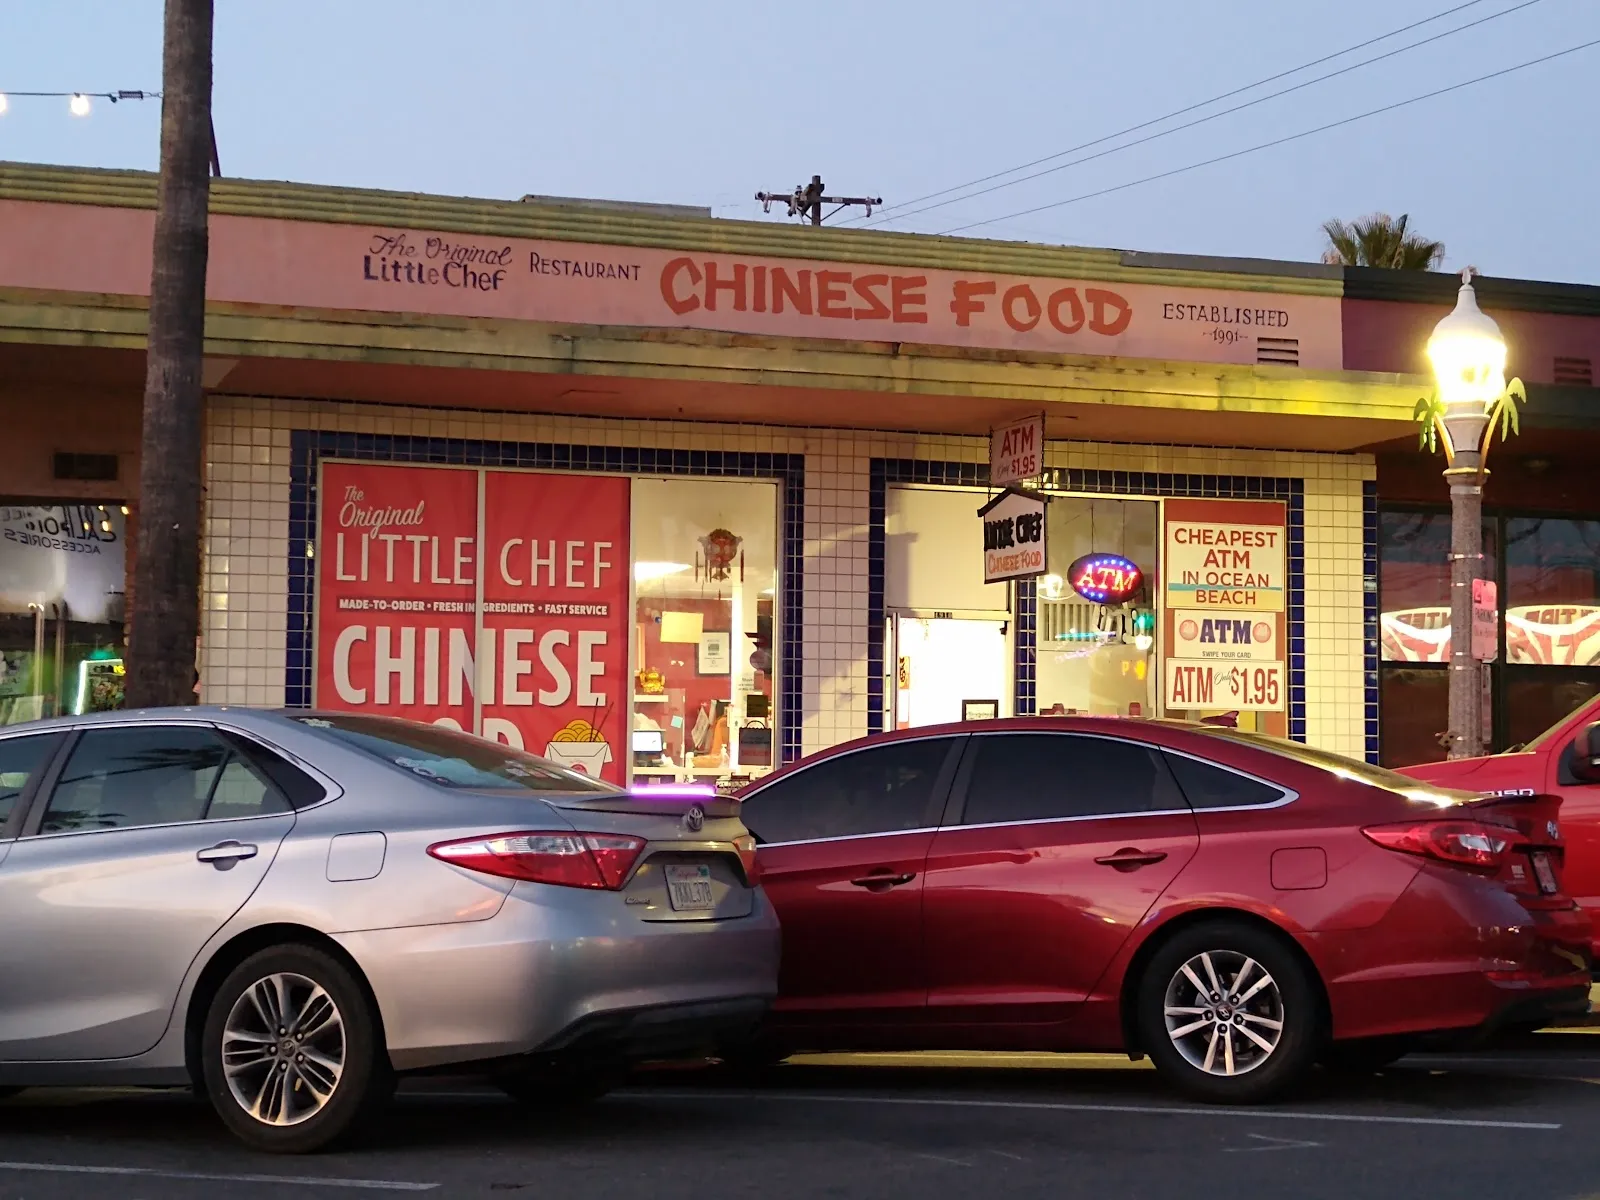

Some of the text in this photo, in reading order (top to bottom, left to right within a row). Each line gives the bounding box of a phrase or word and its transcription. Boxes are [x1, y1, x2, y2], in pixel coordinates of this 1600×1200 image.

[369, 233, 513, 267] The Original
[363, 254, 508, 292] Little Chef
[529, 251, 642, 282] RESTAURANT
[660, 257, 1133, 336] CHINESE FOOD
[1162, 302, 1290, 328] ESTABLISHED
[1000, 424, 1034, 458] ATM
[1011, 454, 1036, 475] $1.95
[344, 485, 364, 502] The
[339, 500, 425, 538] Original
[1174, 527, 1278, 548] CHEAPEST
[336, 533, 612, 588] LITTLE CHEF
[1203, 548, 1250, 569] ATM
[1077, 563, 1137, 592] ATM
[1182, 570, 1270, 588] IN OCEAN
[339, 599, 425, 611] MADE-TO-ORDER
[433, 601, 463, 613] FRESH
[544, 604, 568, 615] FAST
[569, 604, 608, 616] SERVICE
[1195, 589, 1256, 605] BEACH
[1199, 618, 1252, 645] ATM
[333, 625, 607, 707] CHINESE
[1202, 650, 1219, 658] SWIPE
[1236, 651, 1252, 659] CARD
[1172, 666, 1279, 705] ATM Only $1.95
